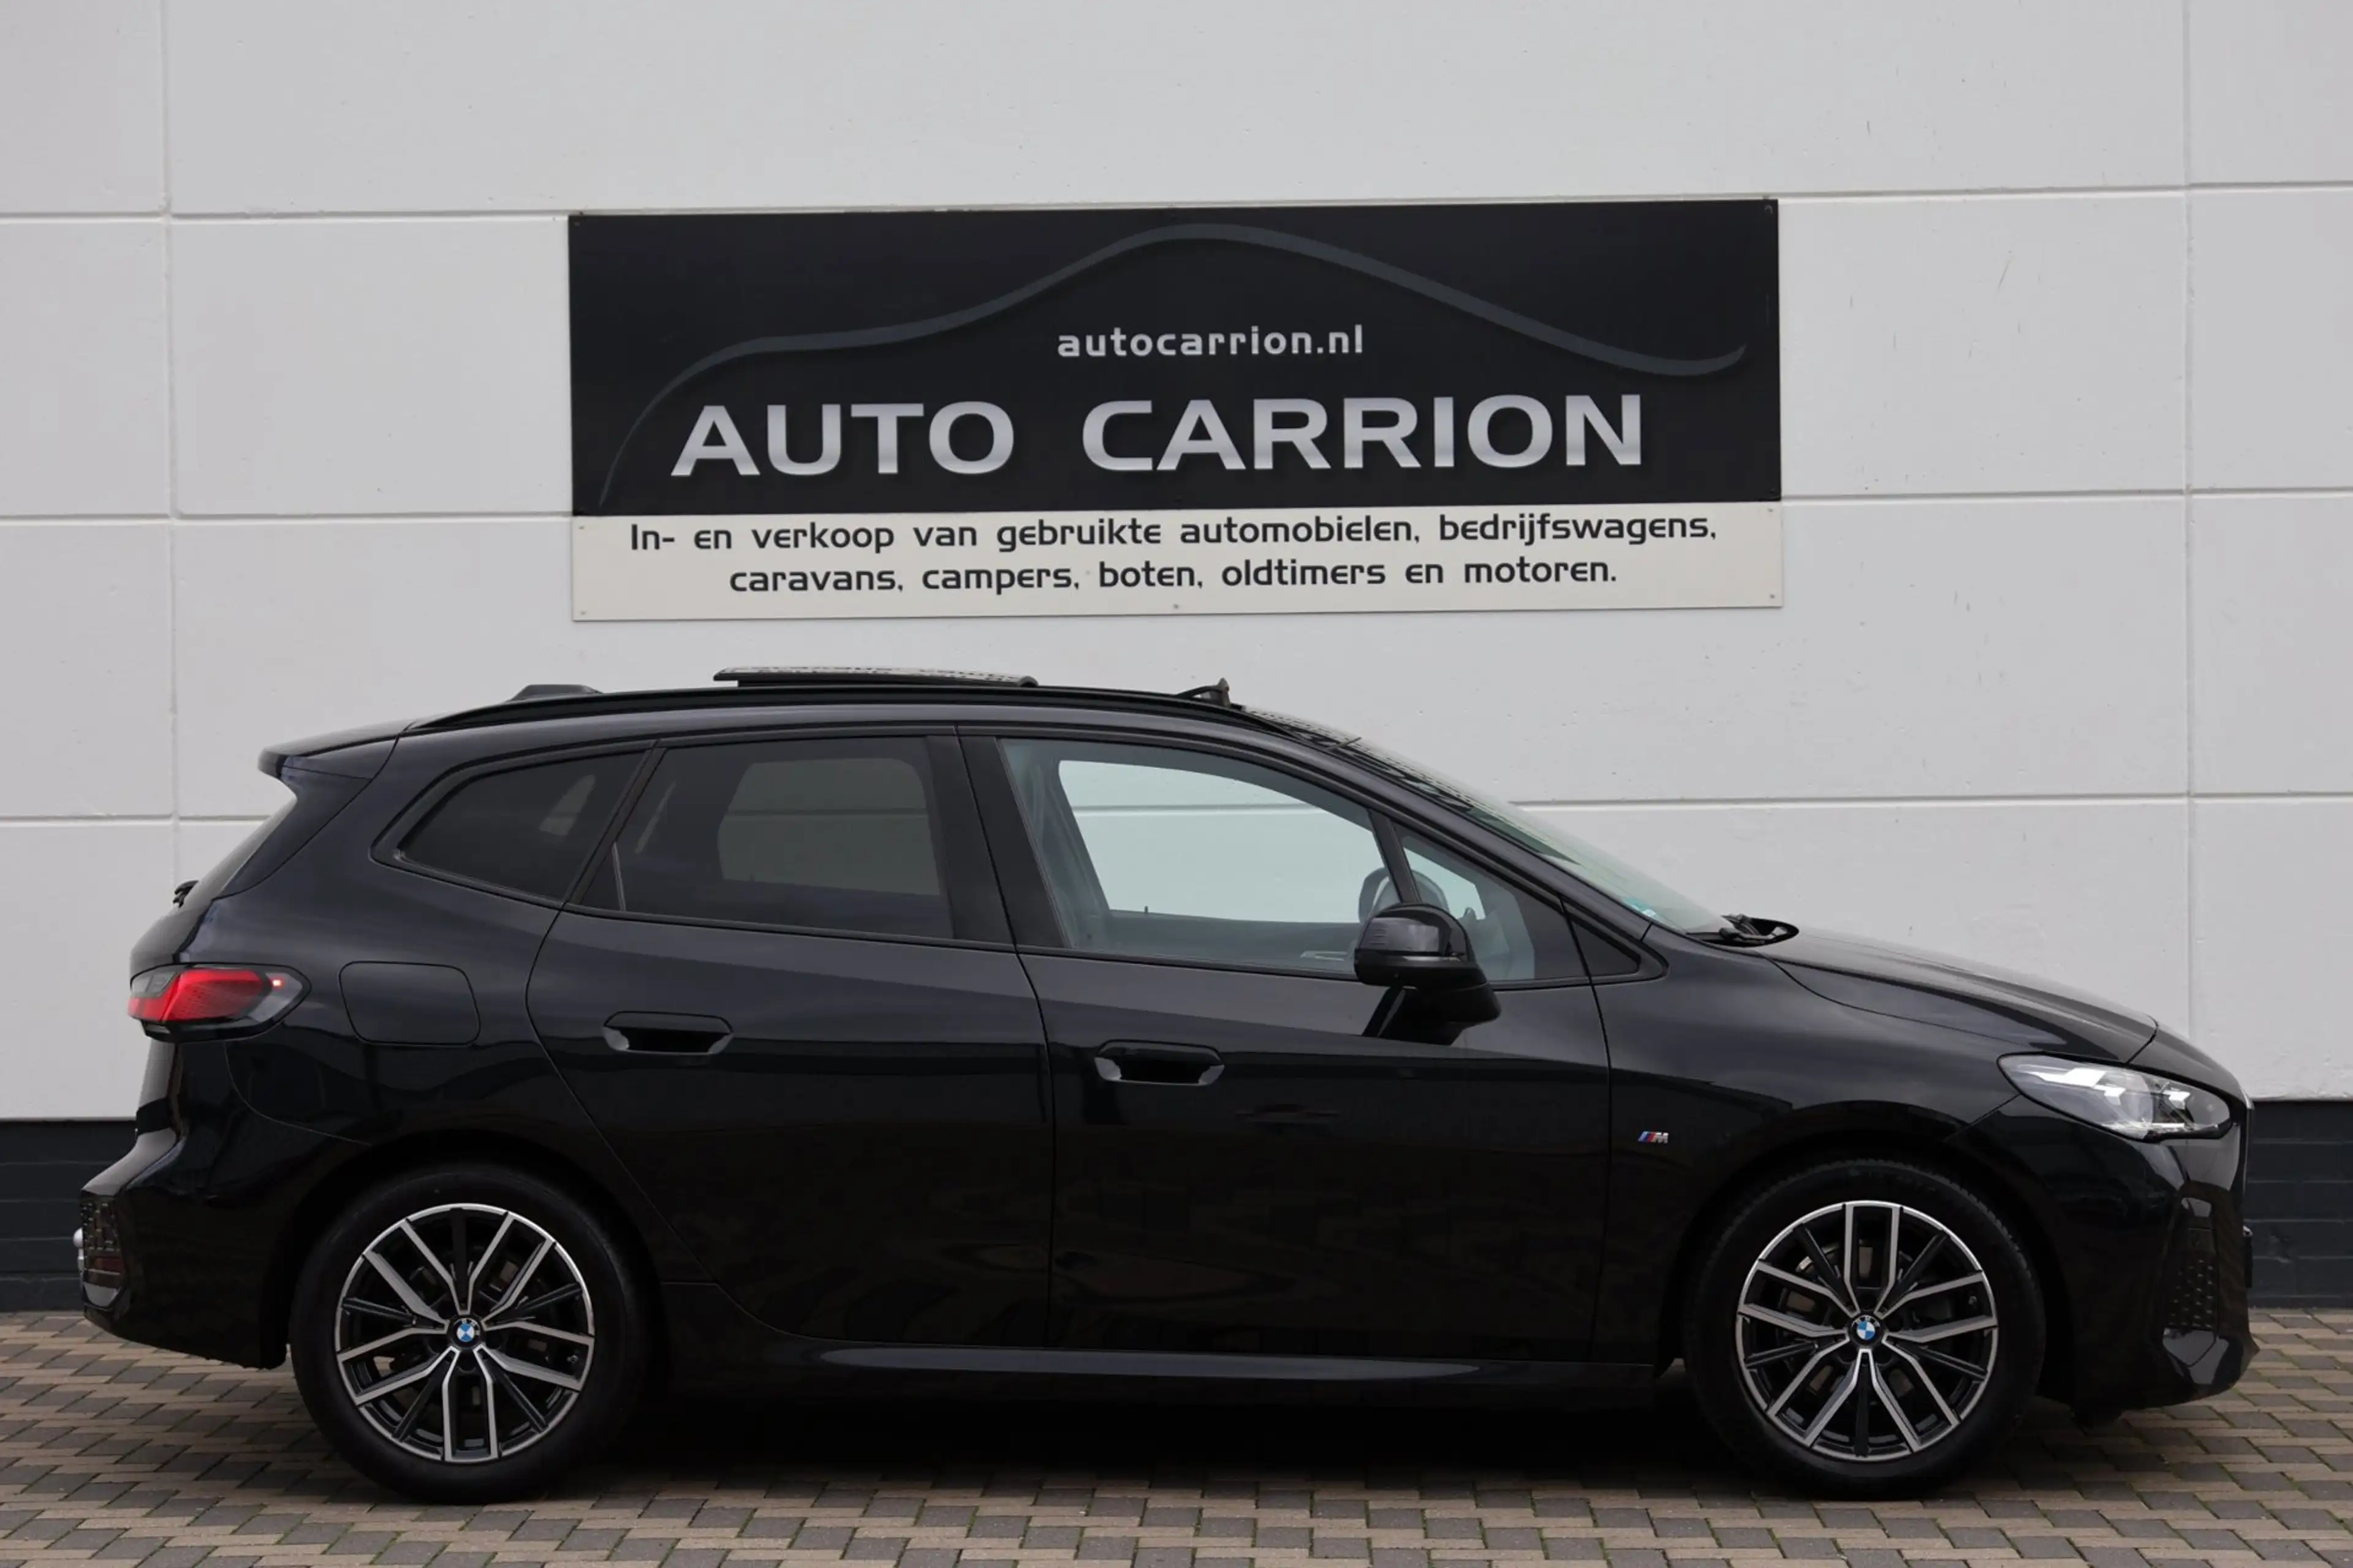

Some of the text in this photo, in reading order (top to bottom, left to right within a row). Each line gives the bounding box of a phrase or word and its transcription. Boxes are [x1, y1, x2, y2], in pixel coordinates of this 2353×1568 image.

[1058, 324, 1363, 357] autocarrion.nl
[670, 394, 1642, 477] AUTO CARRION
[631, 513, 1716, 554] In- en verkoop van gebruikte automobielen, bedrijfswagens,
[730, 556, 1616, 596] caravans, campers, boten, oldtimers en motoren.
